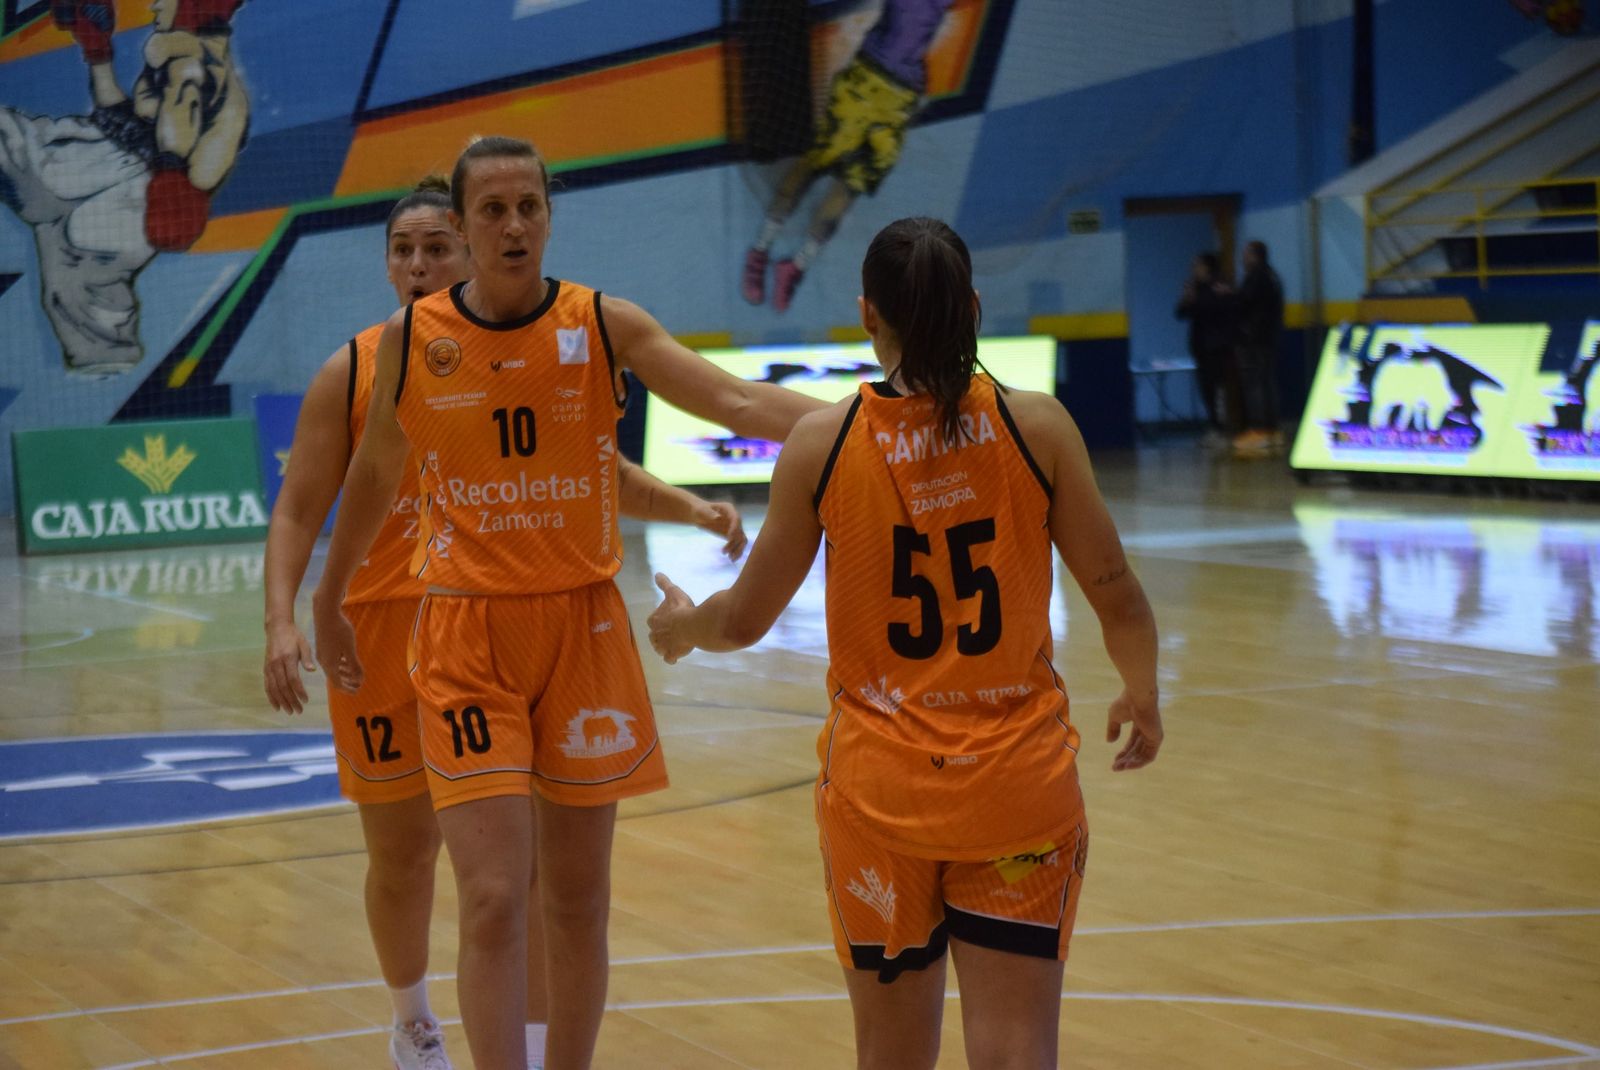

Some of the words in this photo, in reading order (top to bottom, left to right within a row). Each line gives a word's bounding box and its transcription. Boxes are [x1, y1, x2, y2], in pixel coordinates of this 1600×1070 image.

[502, 360, 525, 368] WIBO
[492, 406, 536, 458] 10
[447, 472, 592, 507] Recoletas
[599, 465, 611, 555] VALCARCE
[911, 486, 977, 515] ZAMORA
[31, 502, 140, 540] CAJA
[142, 493, 269, 533] RURA
[476, 511, 565, 534] Zamora
[887, 517, 1002, 660] 55
[922, 689, 971, 708] CAJA
[356, 716, 402, 763] 12
[443, 705, 492, 759] 10
[946, 755, 978, 766] WIBO
